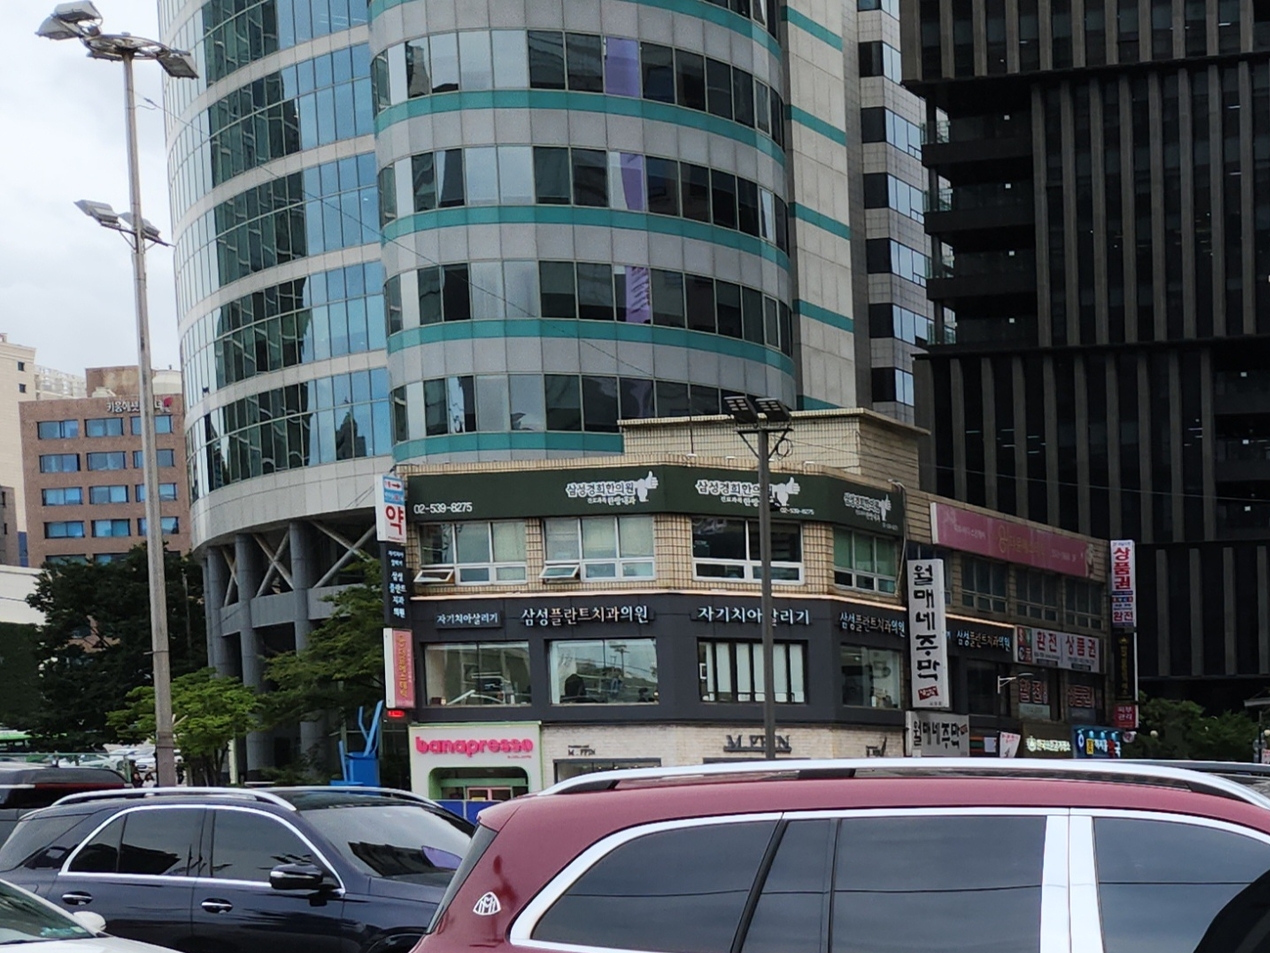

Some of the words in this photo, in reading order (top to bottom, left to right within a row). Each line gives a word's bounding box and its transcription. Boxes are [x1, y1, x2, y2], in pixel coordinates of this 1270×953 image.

[566, 480, 636, 498] 삼성경희한의원
[385, 505, 404, 535] 약
[413, 502, 473, 514] 02-539-8275
[1113, 547, 1131, 590] 상품권
[436, 612, 499, 626] 자기치아살리기
[521, 605, 649, 627] 삼성플란트치과의원
[839, 611, 906, 637] 삼성플란트치과의원
[913, 563, 941, 682] 월매네주막
[1037, 631, 1057, 653] 환전
[1066, 635, 1096, 658] 상품권
[415, 736, 534, 758] banapresso
